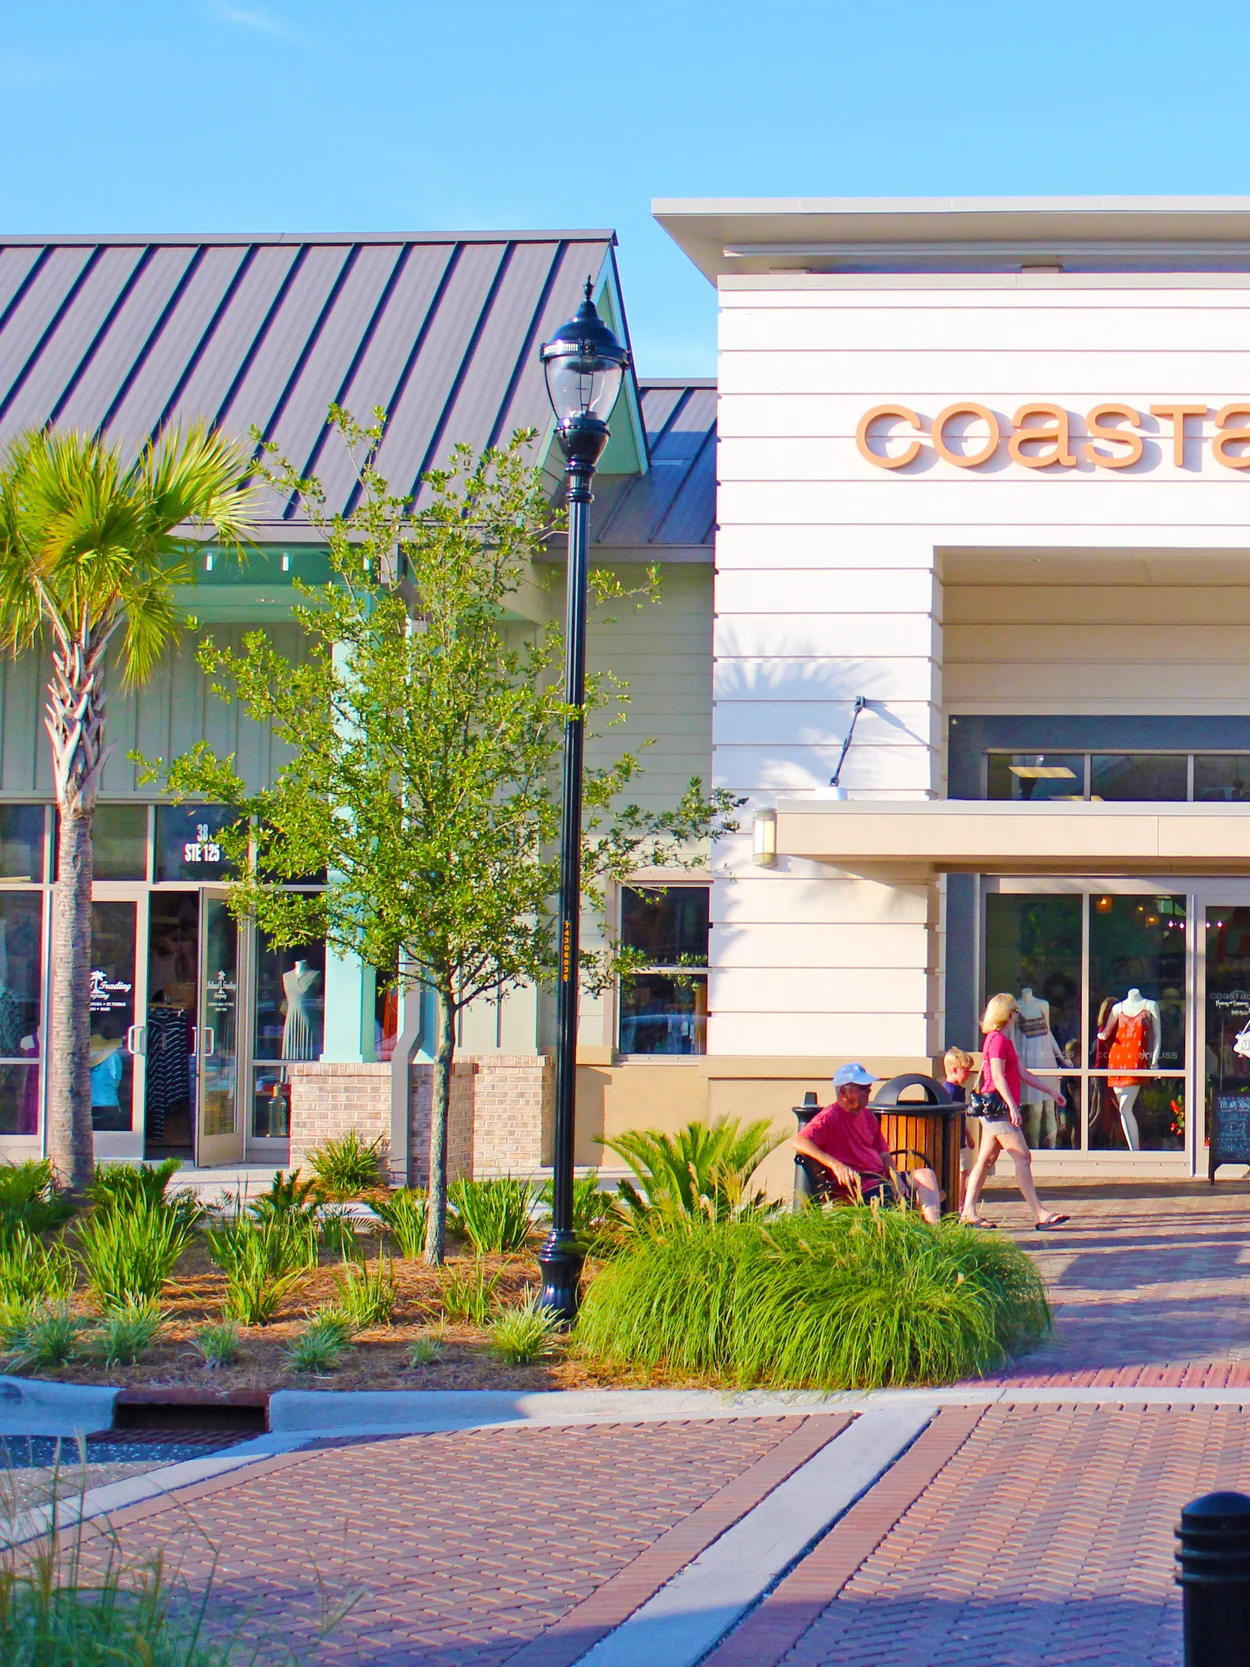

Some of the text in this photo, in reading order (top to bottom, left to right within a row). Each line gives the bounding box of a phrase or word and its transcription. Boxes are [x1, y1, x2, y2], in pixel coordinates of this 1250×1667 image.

[197, 824, 209, 841] 38
[184, 843, 221, 862] STE 125
[99, 981, 132, 992] Trading
